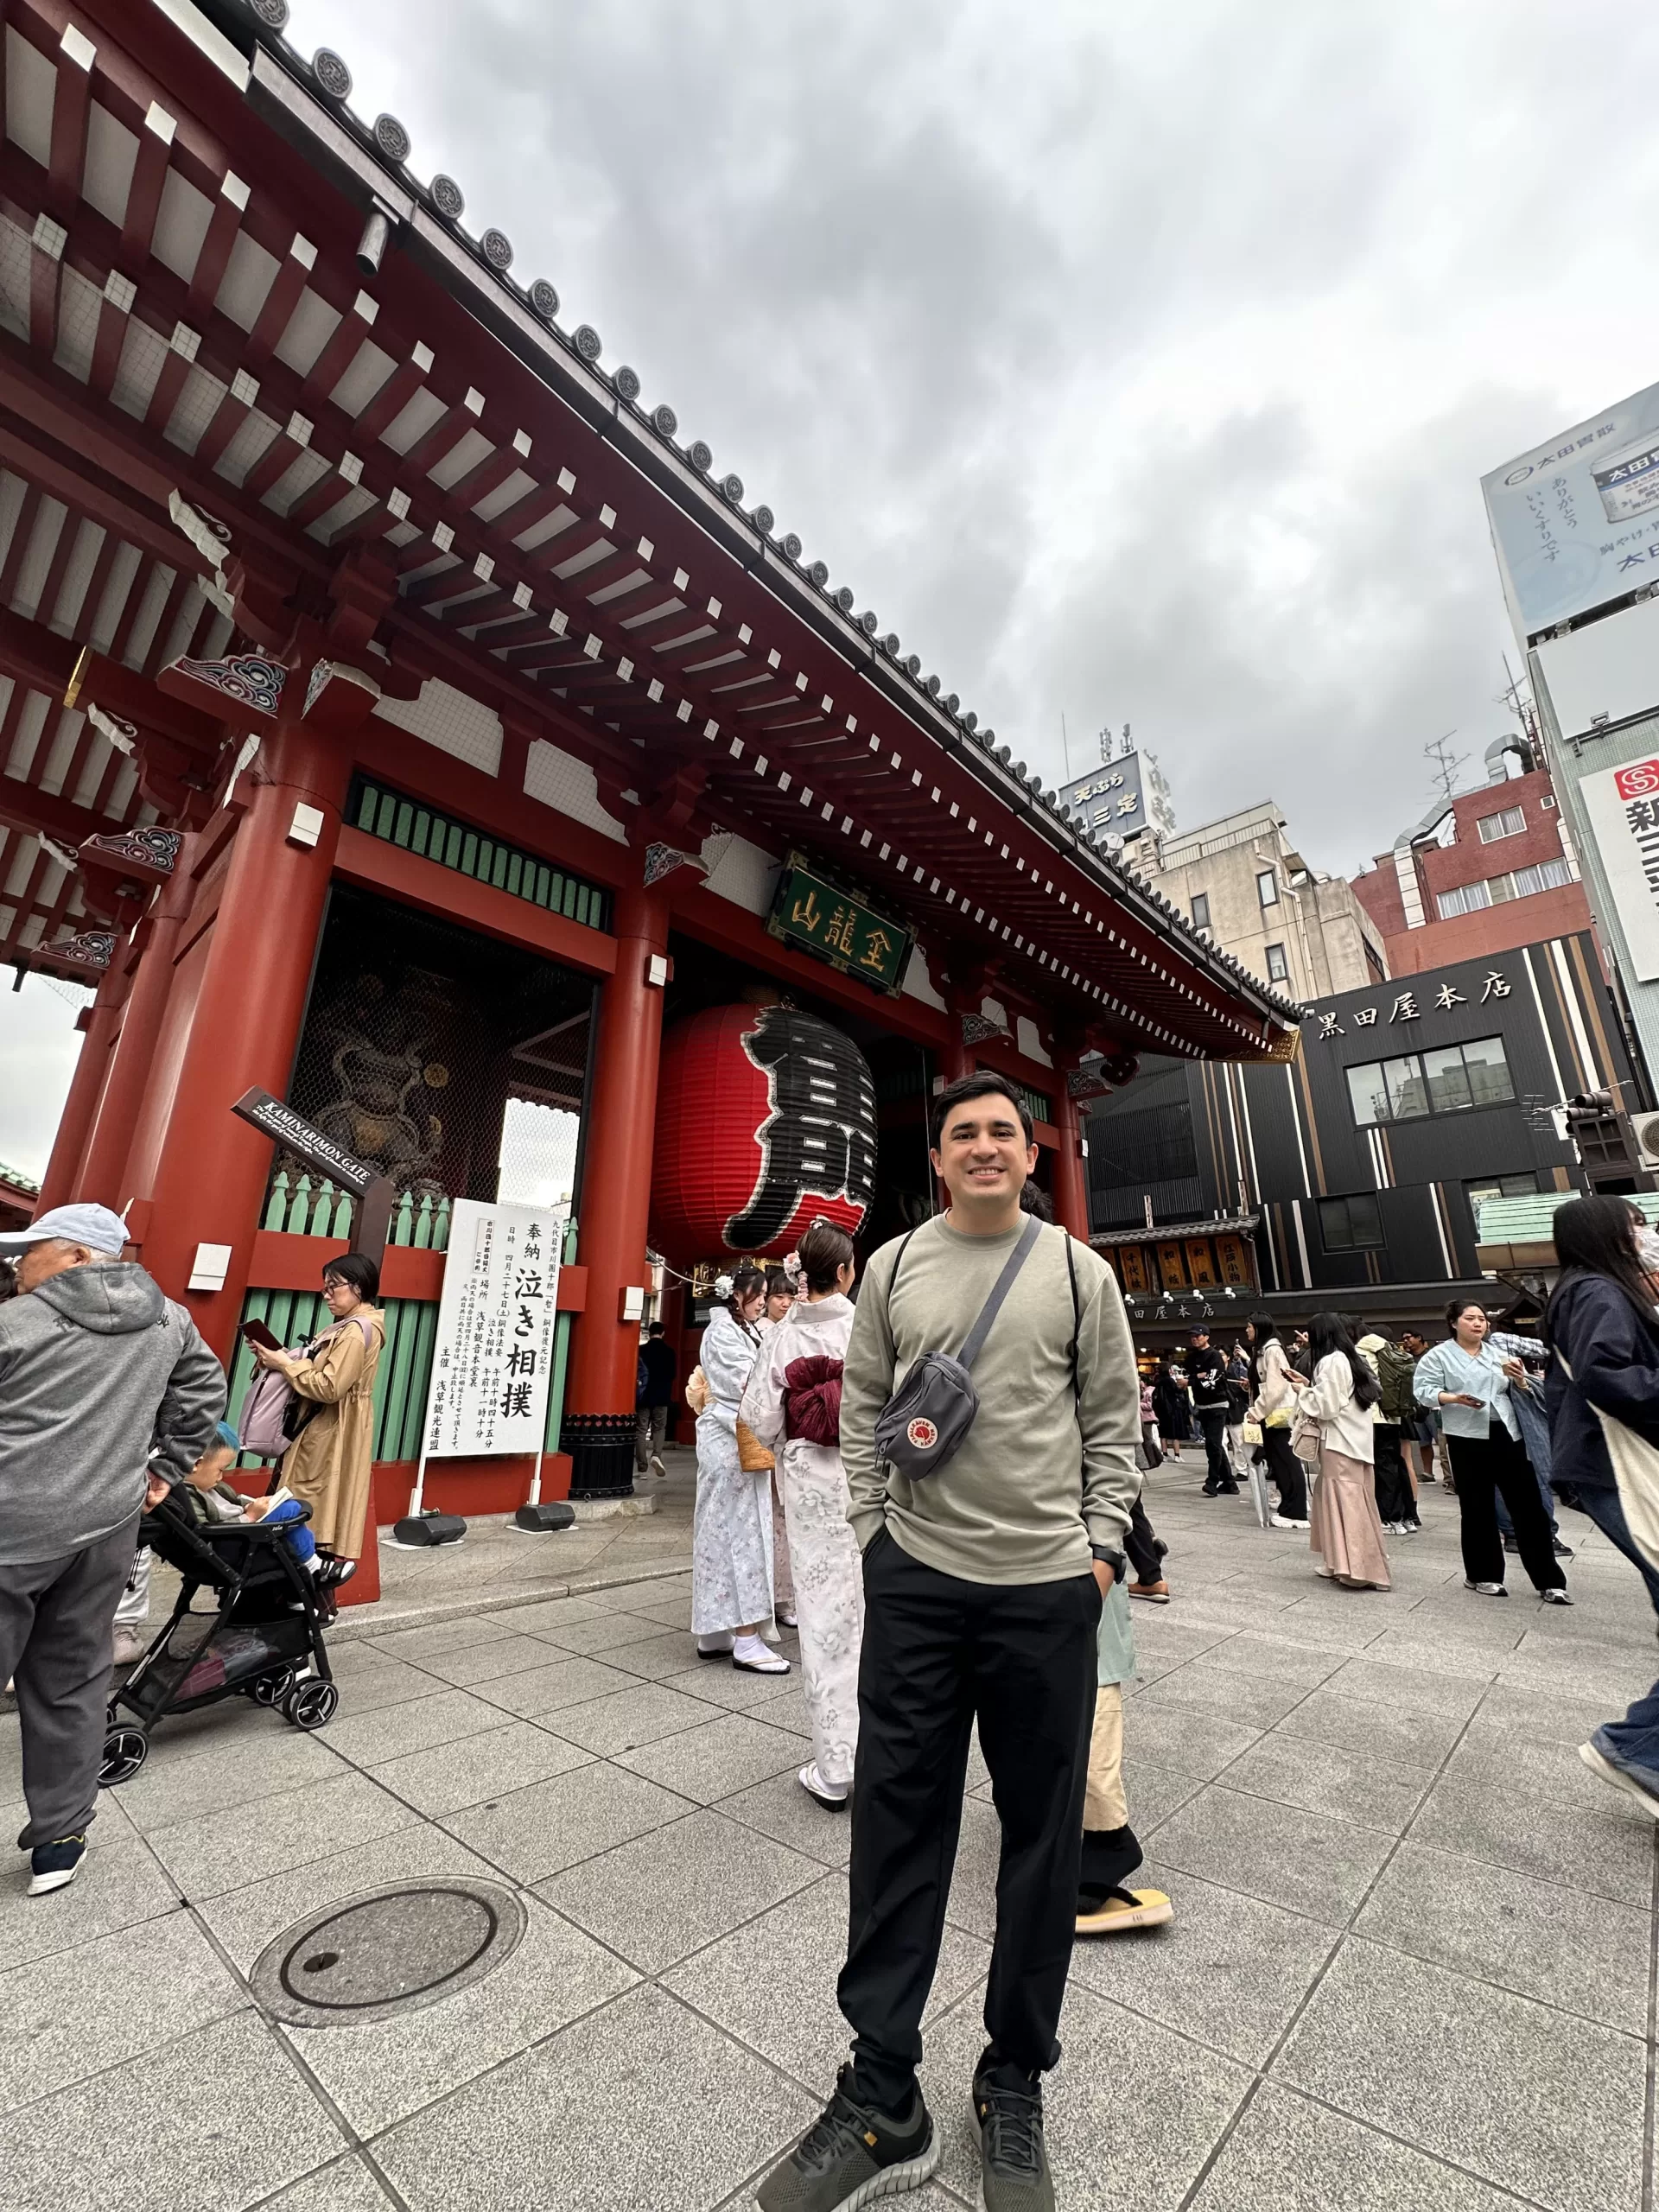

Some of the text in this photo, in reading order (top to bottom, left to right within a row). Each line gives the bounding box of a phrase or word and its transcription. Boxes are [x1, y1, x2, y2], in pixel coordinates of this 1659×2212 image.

[1526, 491, 1560, 562] いいくすりです
[1552, 477, 1578, 529] ありがとう
[1074, 773, 1124, 805] 天ぷら
[1093, 792, 1138, 827] 三定
[1319, 971, 1512, 1039] 黒田屋本店
[264, 1102, 371, 1180] KAMINARIMON GATE
[507, 1226, 516, 1244] 日時
[469, 1279, 489, 1387] 場所 浅草観音本堂裏
[500, 1223, 544, 1419] 奉納 泣き相撲
[429, 1346, 451, 1451] 主催 浅草観光連盟
